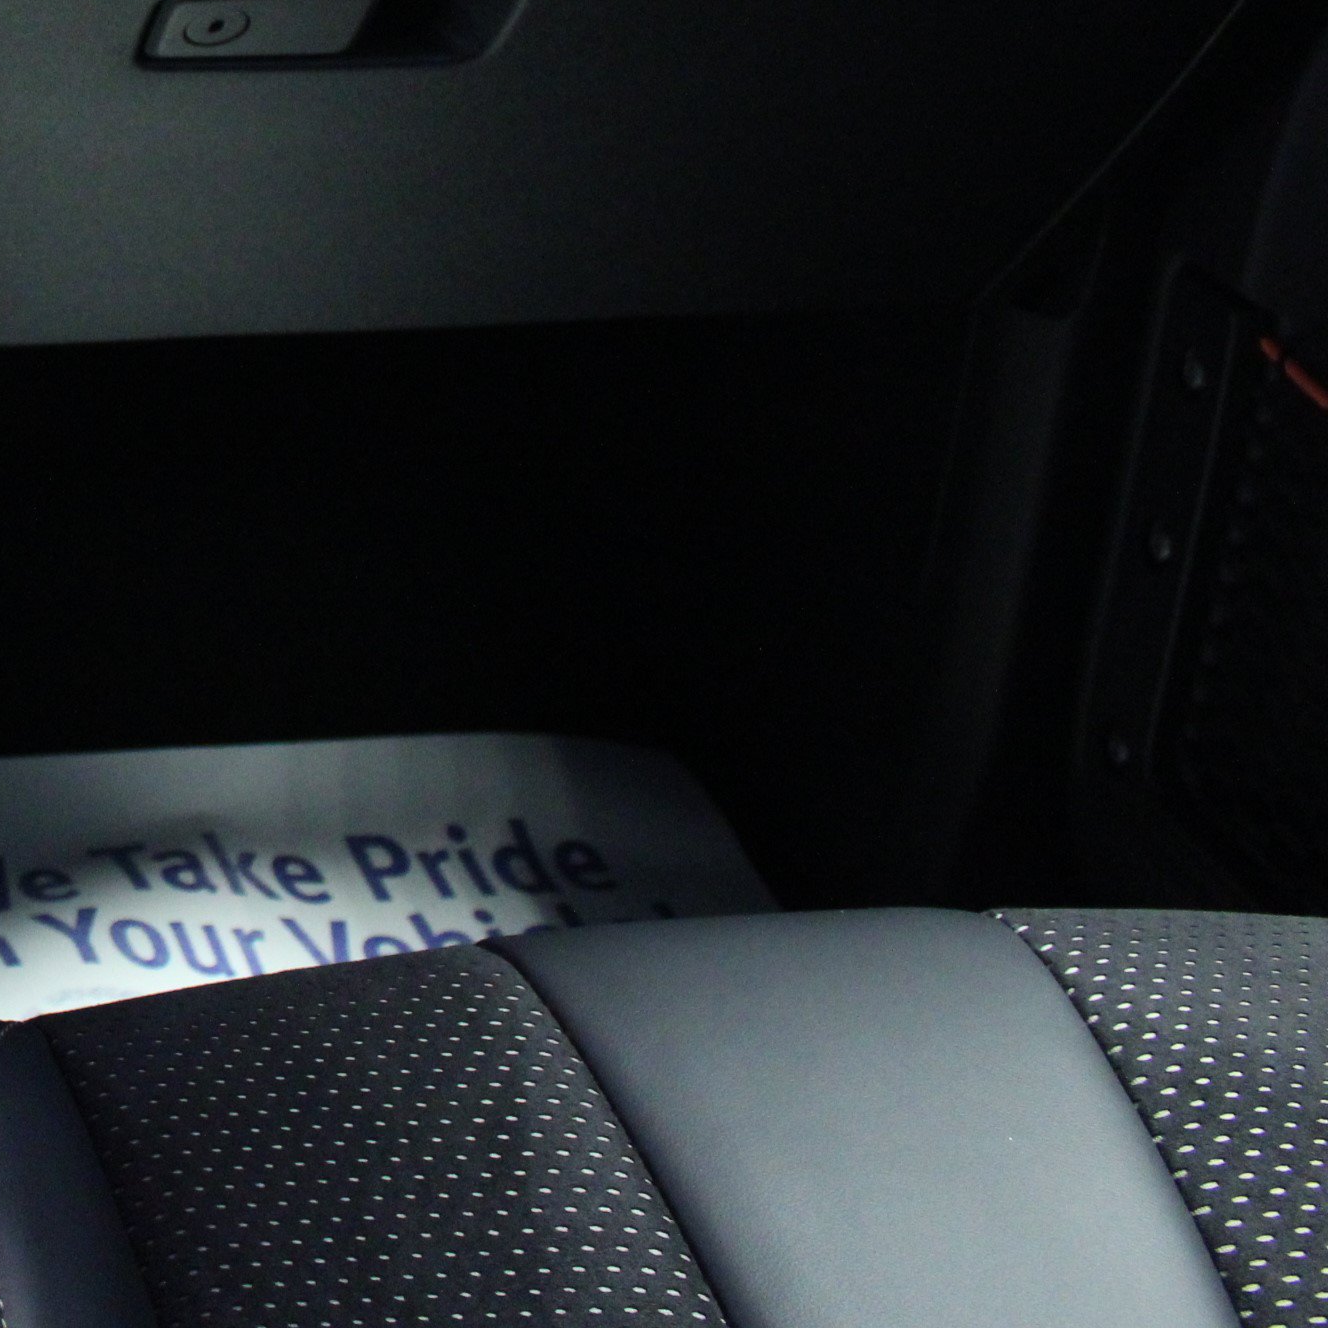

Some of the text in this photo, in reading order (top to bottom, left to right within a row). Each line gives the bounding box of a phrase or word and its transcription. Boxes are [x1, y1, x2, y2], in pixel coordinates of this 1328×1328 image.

[88, 829, 332, 904] Take
[344, 817, 618, 901] Pride
[35, 906, 267, 976] Your
